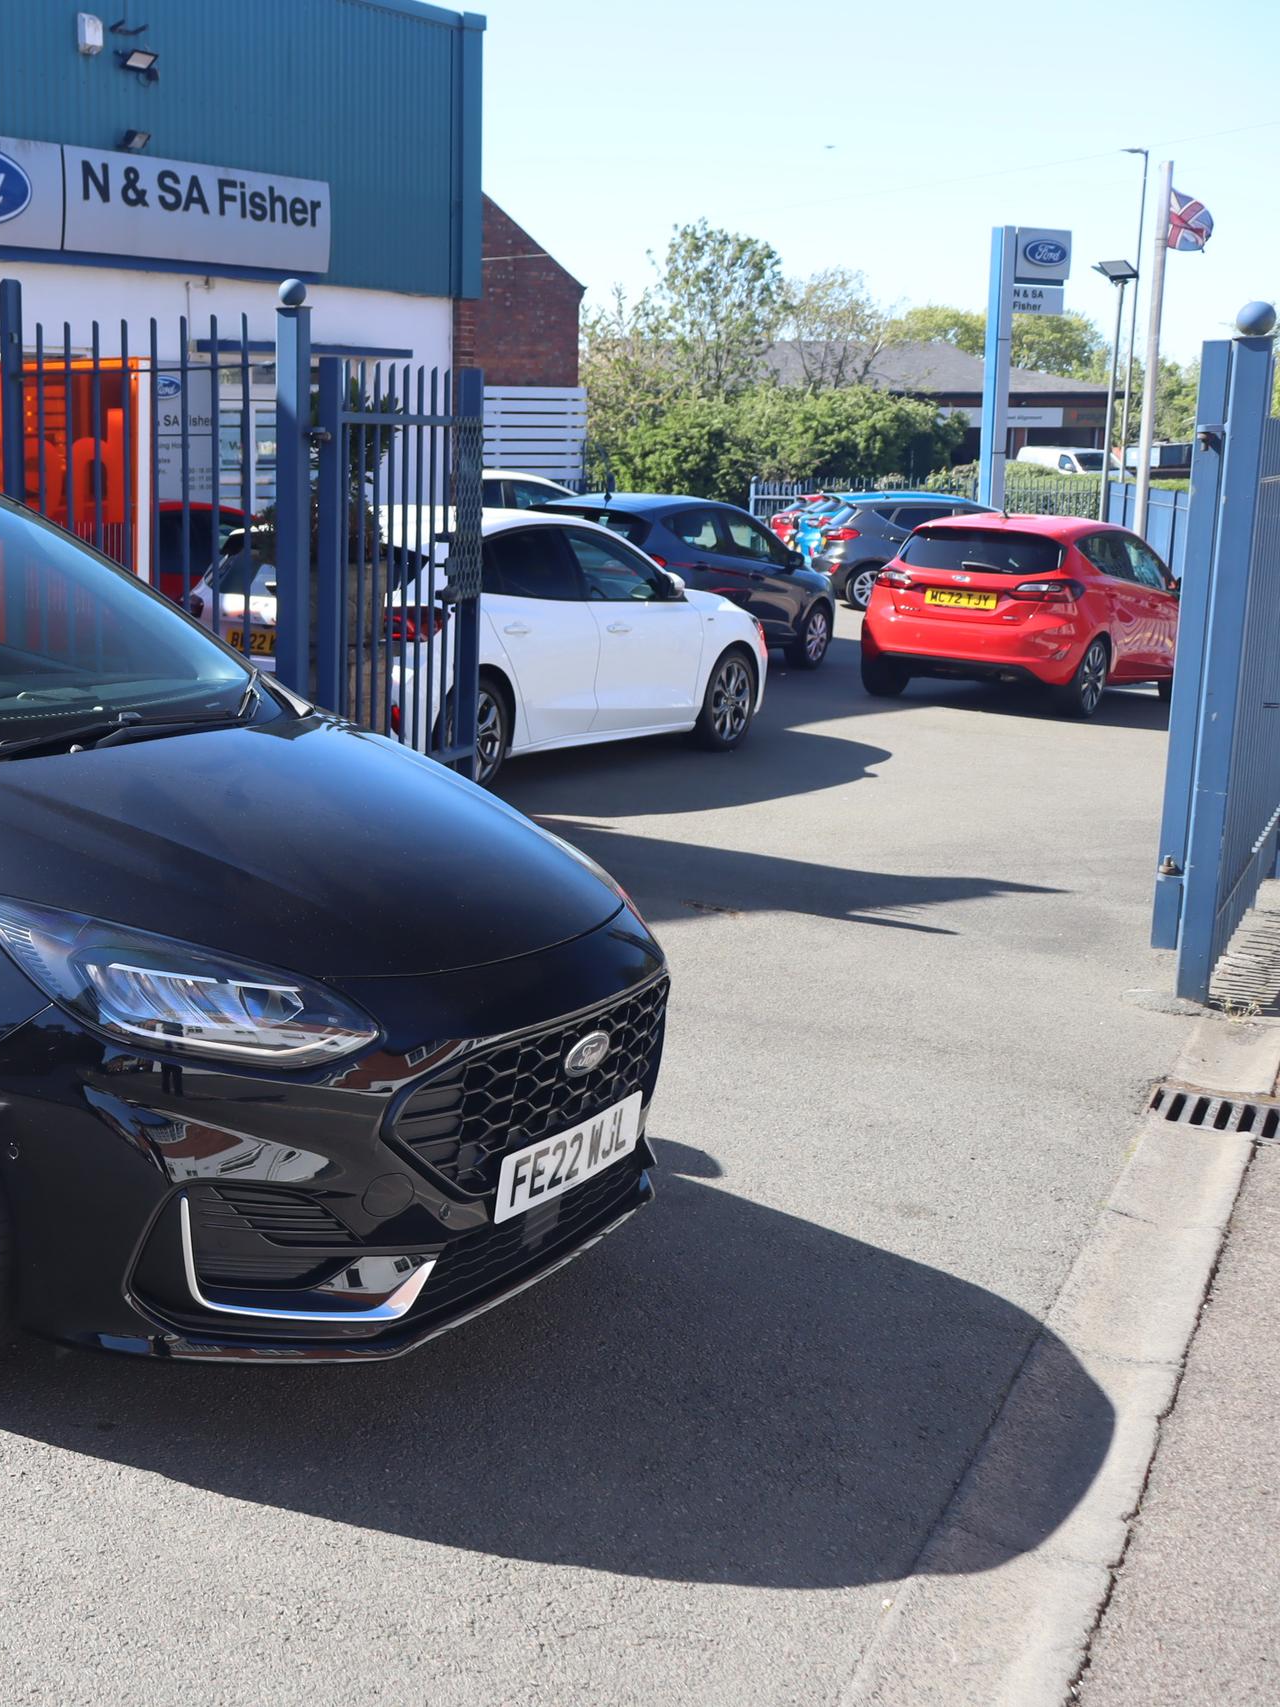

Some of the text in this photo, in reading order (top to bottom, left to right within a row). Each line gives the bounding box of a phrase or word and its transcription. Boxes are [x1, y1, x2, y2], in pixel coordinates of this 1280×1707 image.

[81, 159, 322, 227] N & SA Fisher
[1034, 243, 1062, 261] Ford
[1013, 289, 1021, 298] N
[1022, 289, 1029, 298] &
[1012, 300, 1042, 311] Fisher
[163, 414, 180, 426] SA
[966, 593, 990, 606] TJY
[509, 1108, 627, 1208] FE22 WJL
